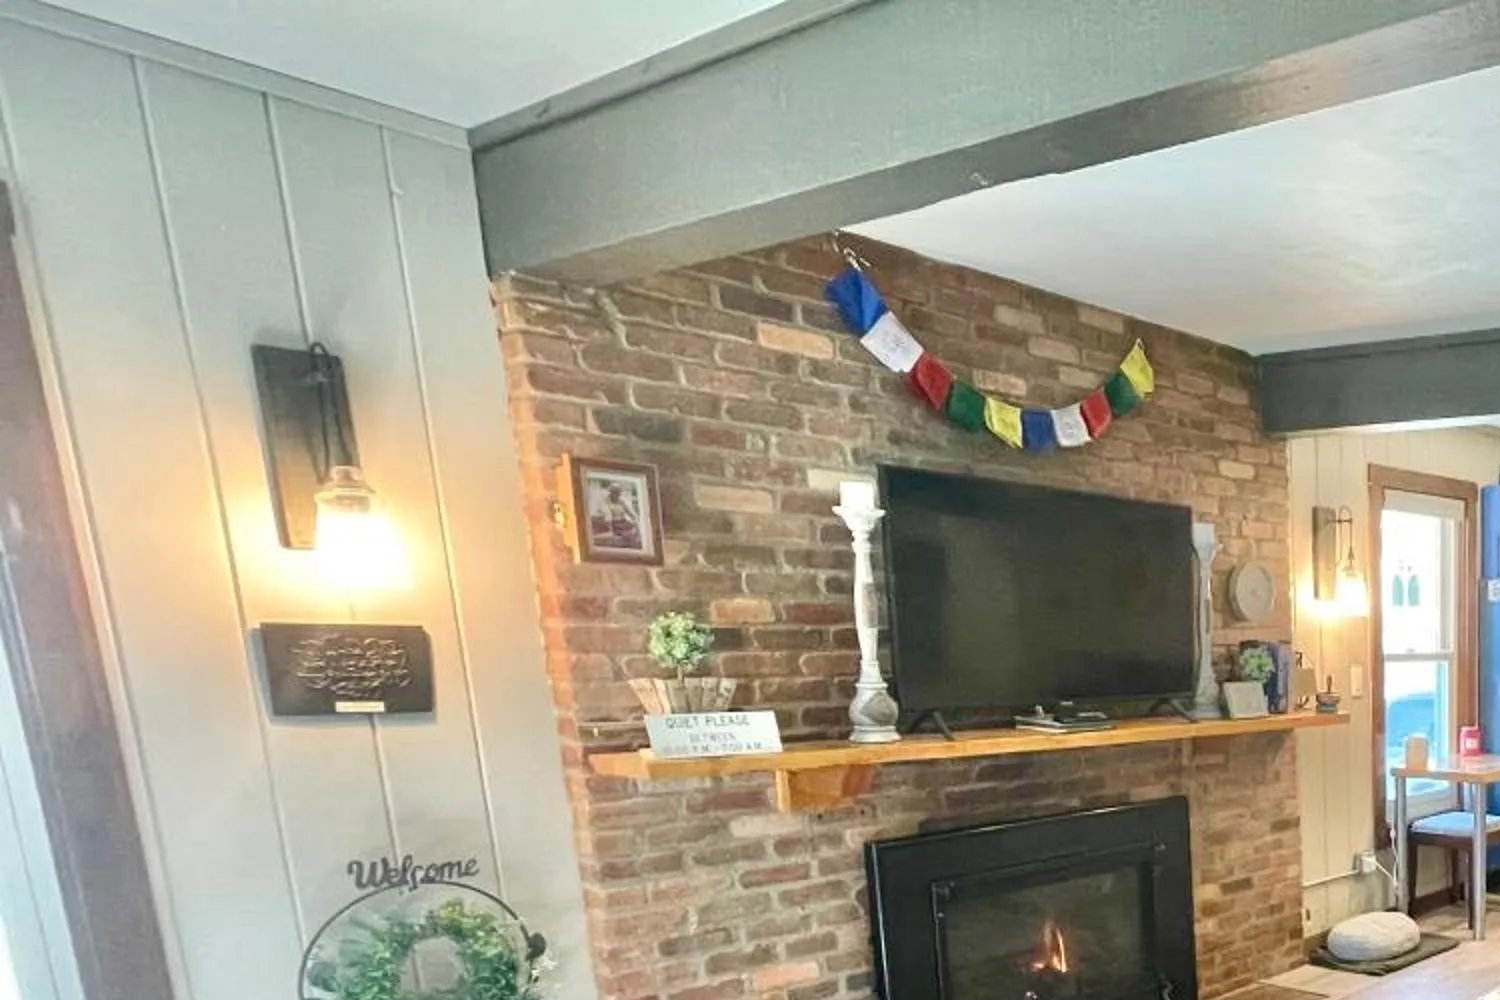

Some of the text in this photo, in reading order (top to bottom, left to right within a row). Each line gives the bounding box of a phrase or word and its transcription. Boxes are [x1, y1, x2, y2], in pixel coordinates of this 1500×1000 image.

[665, 714, 750, 729] QUIET PLEASE
[347, 854, 480, 891] Welcome
